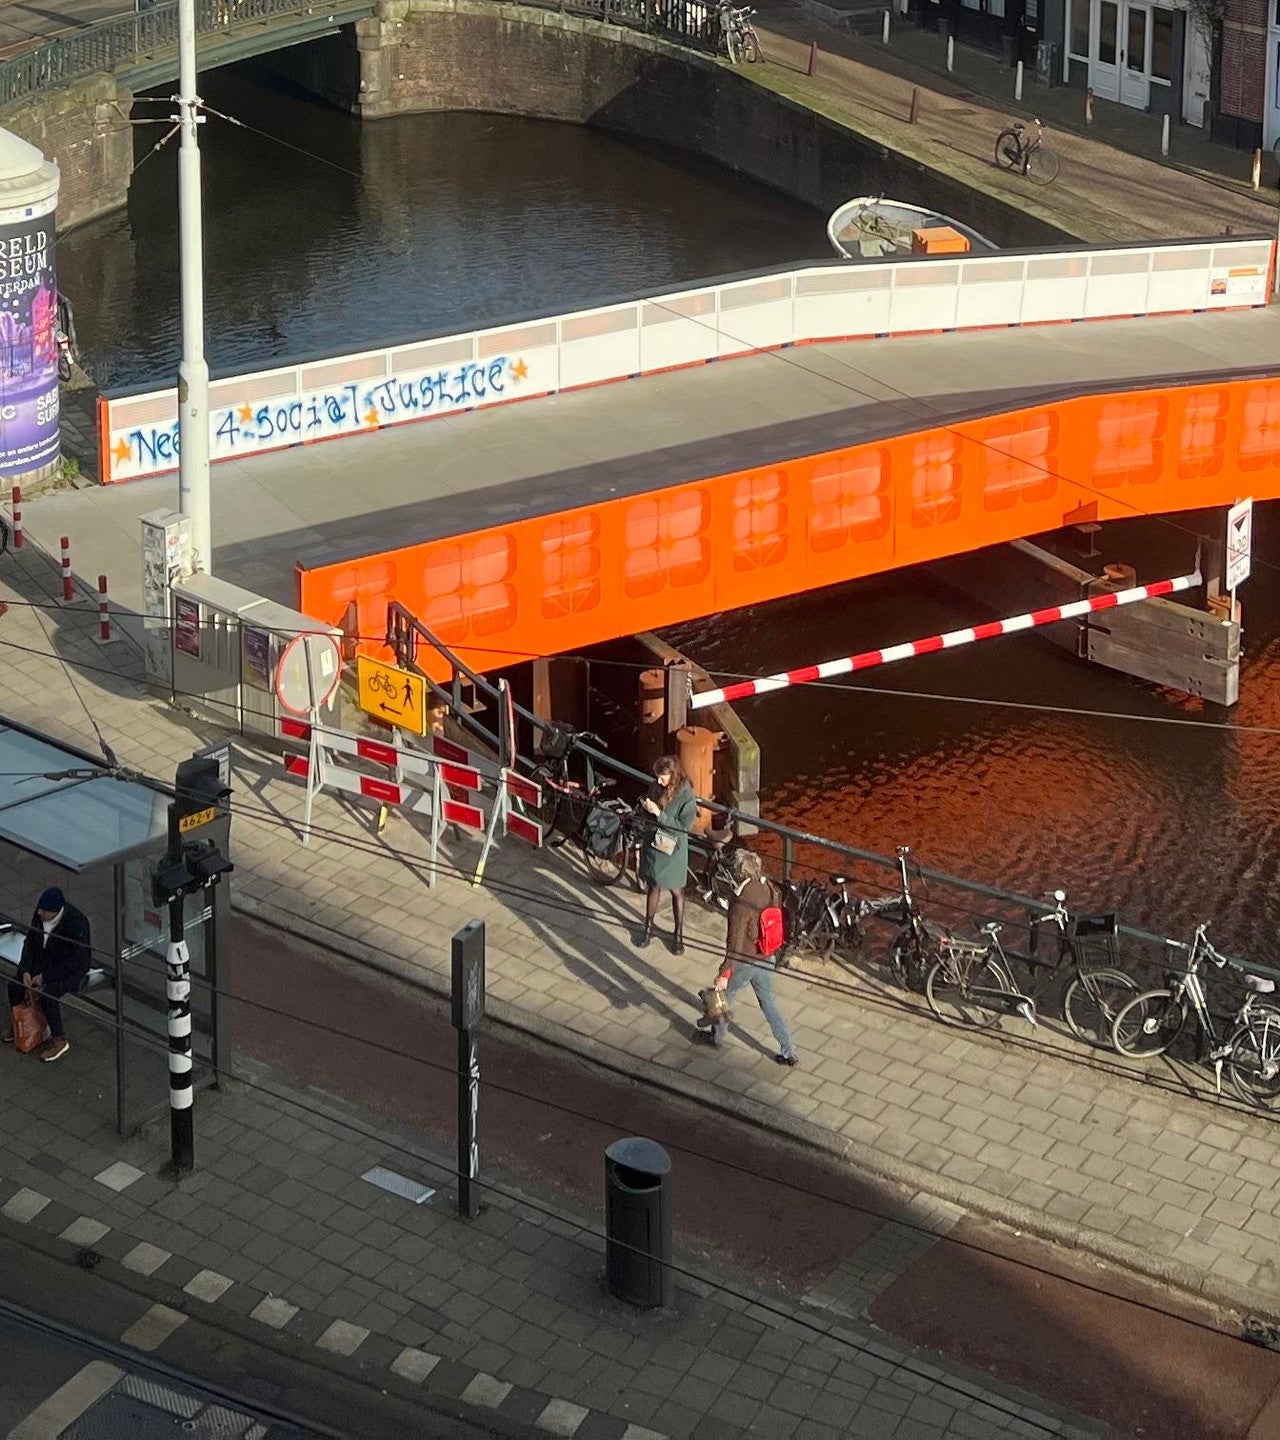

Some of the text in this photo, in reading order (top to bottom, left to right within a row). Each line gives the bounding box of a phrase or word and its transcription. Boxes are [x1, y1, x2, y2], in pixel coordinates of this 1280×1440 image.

[216, 410, 241, 446] 4
[257, 386, 359, 439] Social
[379, 359, 507, 413] Justice
[182, 809, 213, 829] 462-V
